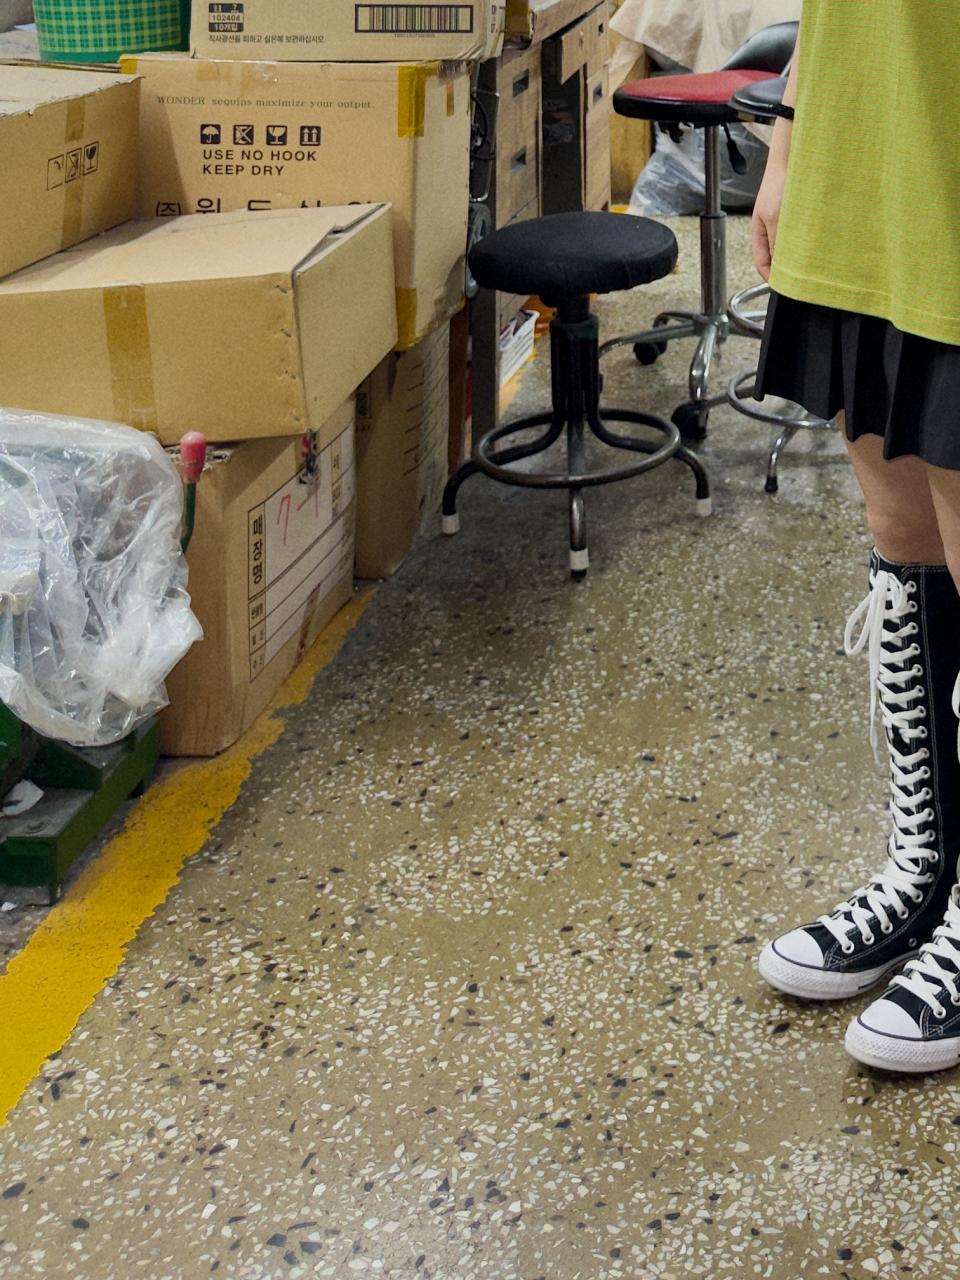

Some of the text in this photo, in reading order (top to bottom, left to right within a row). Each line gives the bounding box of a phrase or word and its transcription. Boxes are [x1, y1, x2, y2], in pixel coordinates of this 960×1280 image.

[157, 95, 206, 106] WONDER
[202, 149, 318, 162] USE NO HOOK
[202, 164, 286, 176] KEEP DRY
